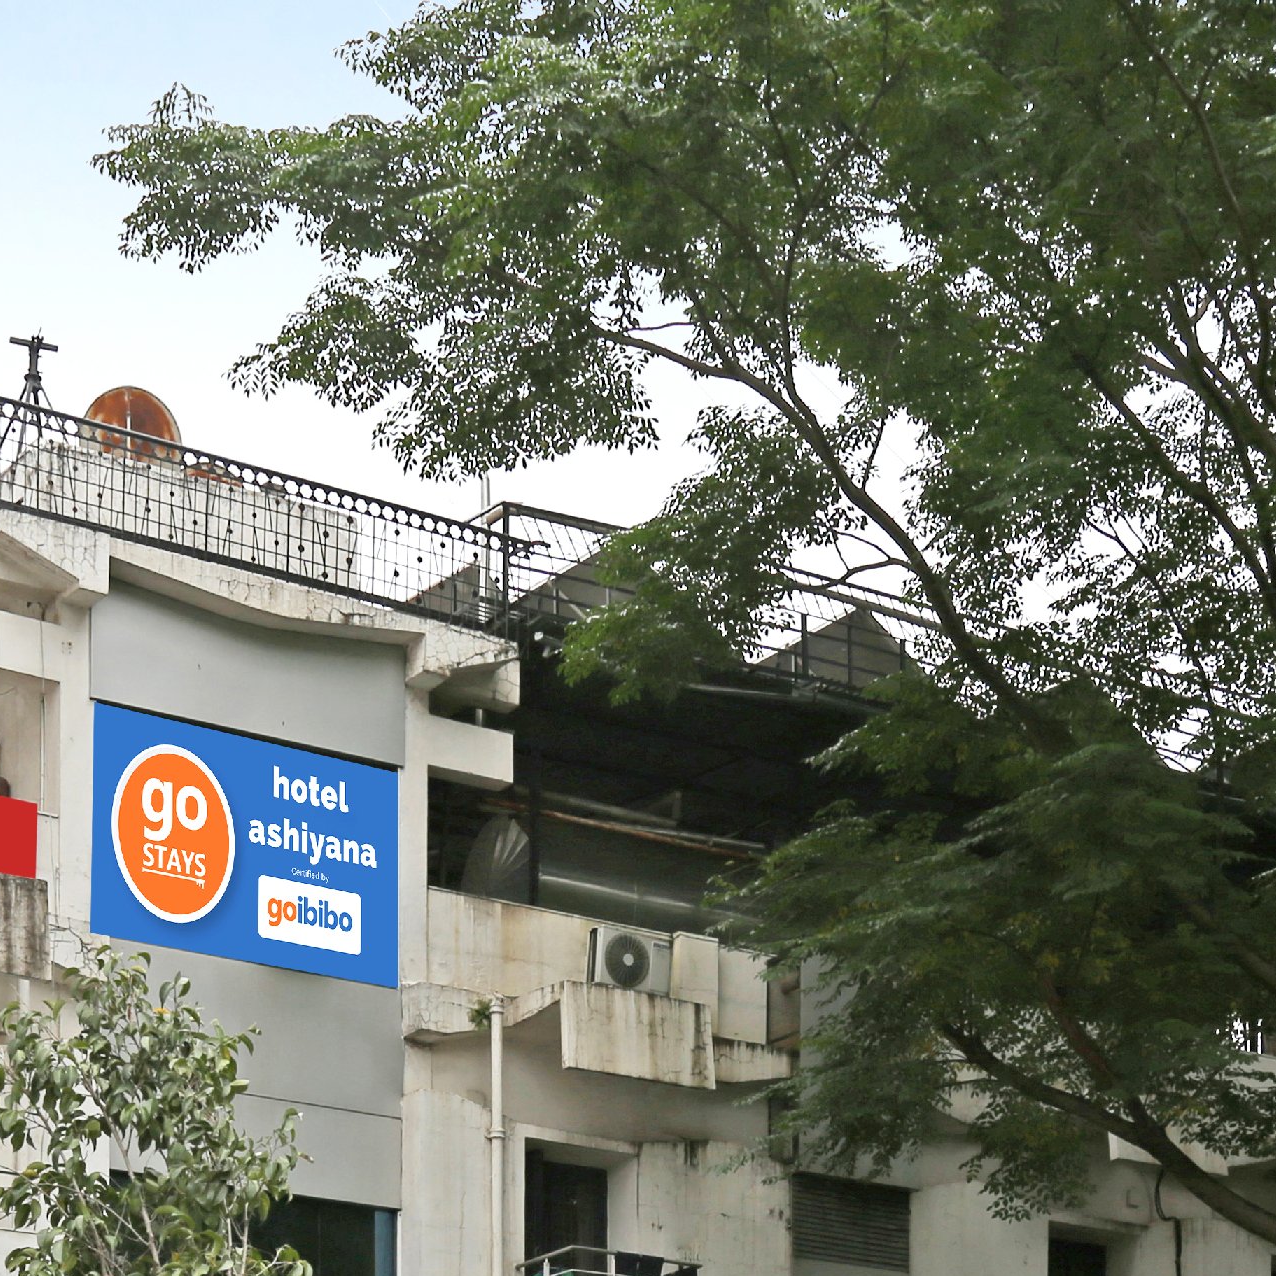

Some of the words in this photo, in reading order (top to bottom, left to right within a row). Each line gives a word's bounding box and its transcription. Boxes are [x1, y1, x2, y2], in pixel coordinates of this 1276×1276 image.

[141, 777, 208, 842] go
[273, 765, 349, 813] hotel
[142, 843, 207, 877] STAYS
[248, 818, 377, 869] ashiyana
[291, 867, 320, 880] Certified
[320, 872, 330, 883] by
[267, 896, 353, 932] goibibo
